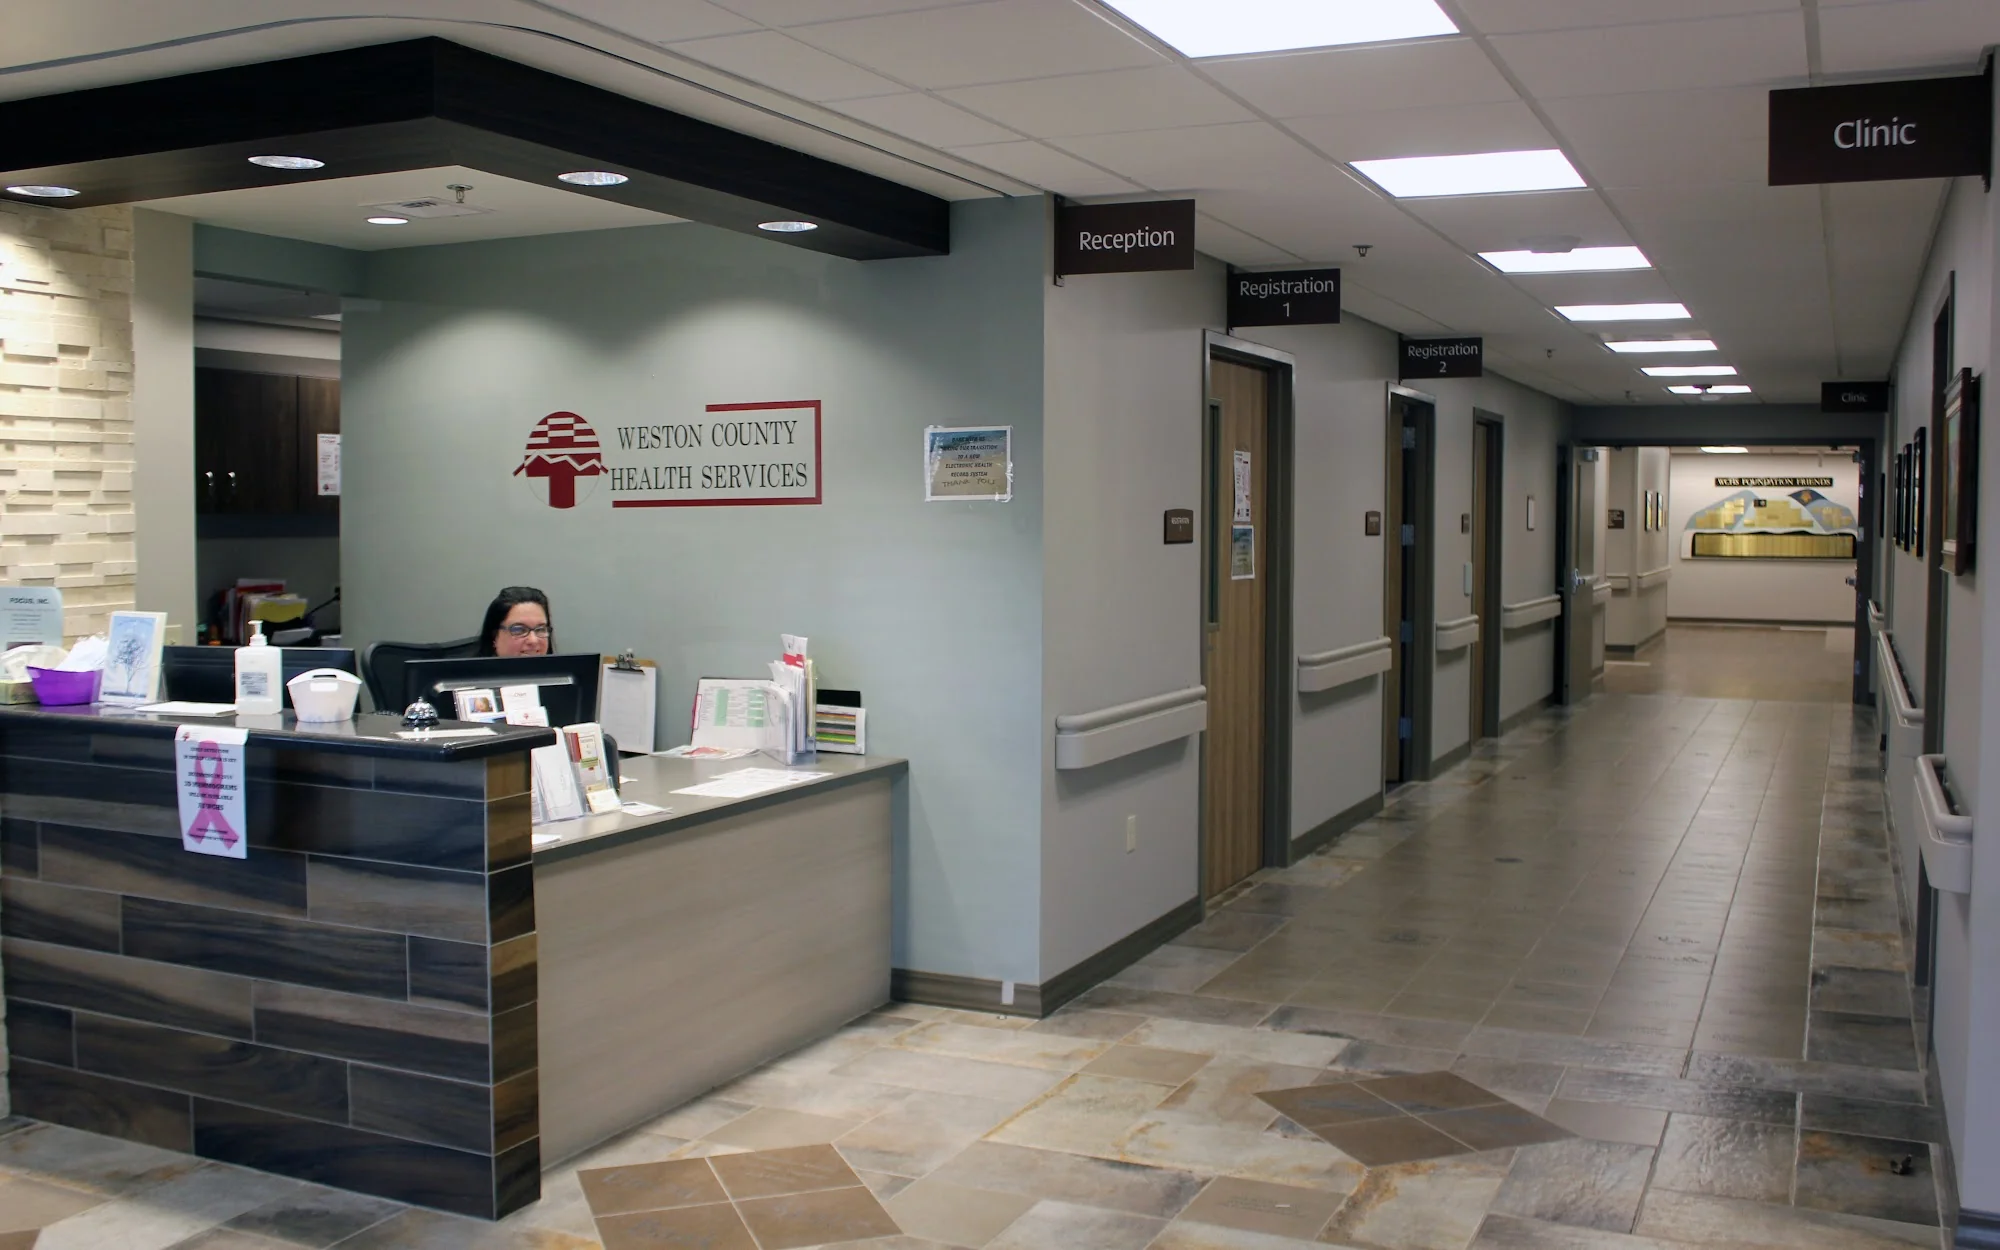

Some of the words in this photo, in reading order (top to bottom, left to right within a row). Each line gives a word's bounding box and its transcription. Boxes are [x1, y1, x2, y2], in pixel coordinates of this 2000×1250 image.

[1833, 116, 1917, 149] Clinic
[1079, 226, 1175, 253] Reception
[1239, 276, 1334, 299] Registration
[1282, 302, 1290, 317] 1
[1407, 343, 1478, 359] Registration
[1439, 361, 1447, 373] 2
[1841, 390, 1868, 403] Clinic
[617, 424, 703, 450] WESTON
[711, 420, 798, 447] COUNTY
[610, 466, 692, 491] HEALTH
[701, 462, 808, 490] SERVICES
[942, 479, 970, 488] THANK
[1742, 477, 1794, 486] FOUNDATION
[1796, 477, 1831, 486] FRIENDS
